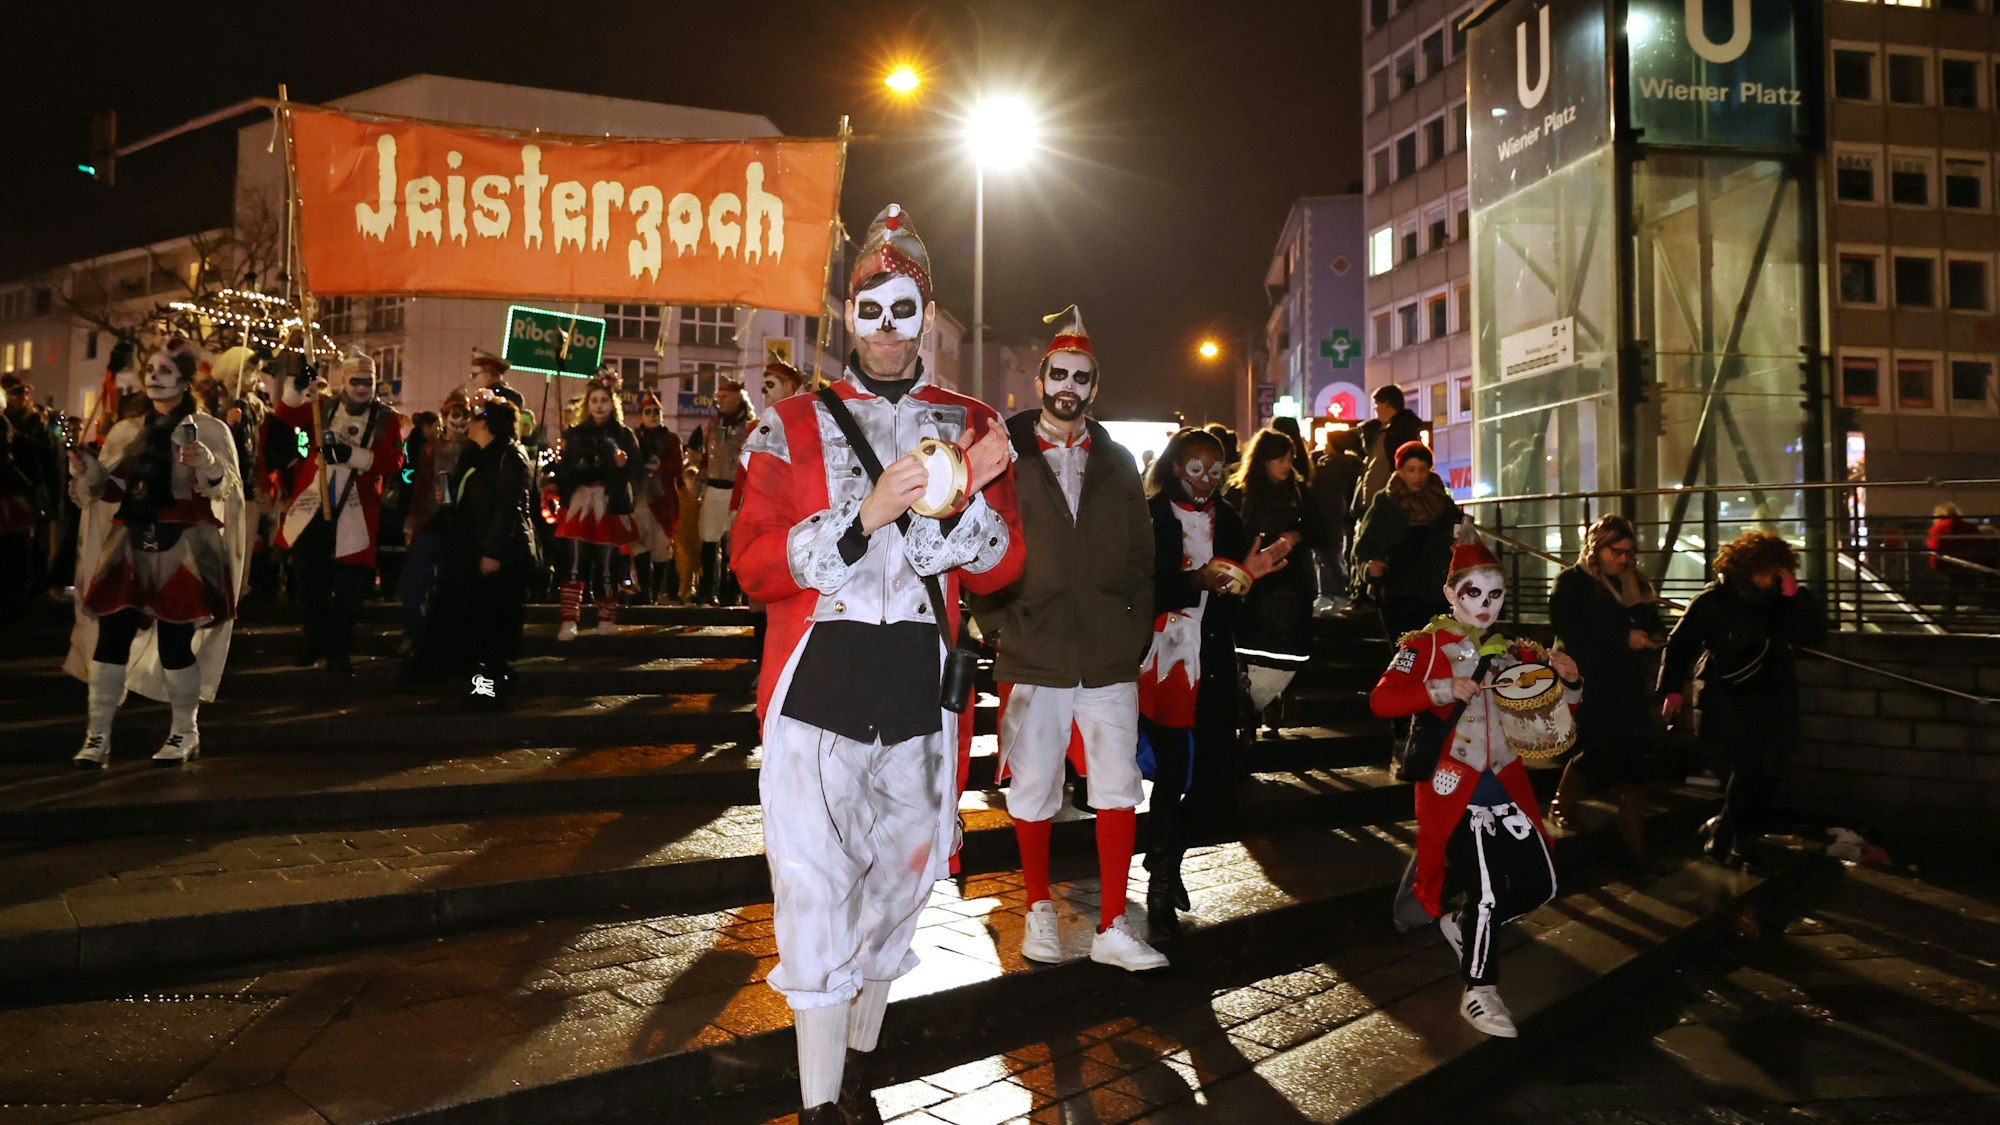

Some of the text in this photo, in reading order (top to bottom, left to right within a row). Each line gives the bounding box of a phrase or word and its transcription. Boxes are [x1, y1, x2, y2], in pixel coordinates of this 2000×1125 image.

[1517, 4, 1549, 109] U
[1685, 0, 1751, 63] U
[1638, 77, 1801, 105] Wiener Platz
[1497, 105, 1576, 162] Wiener Platz
